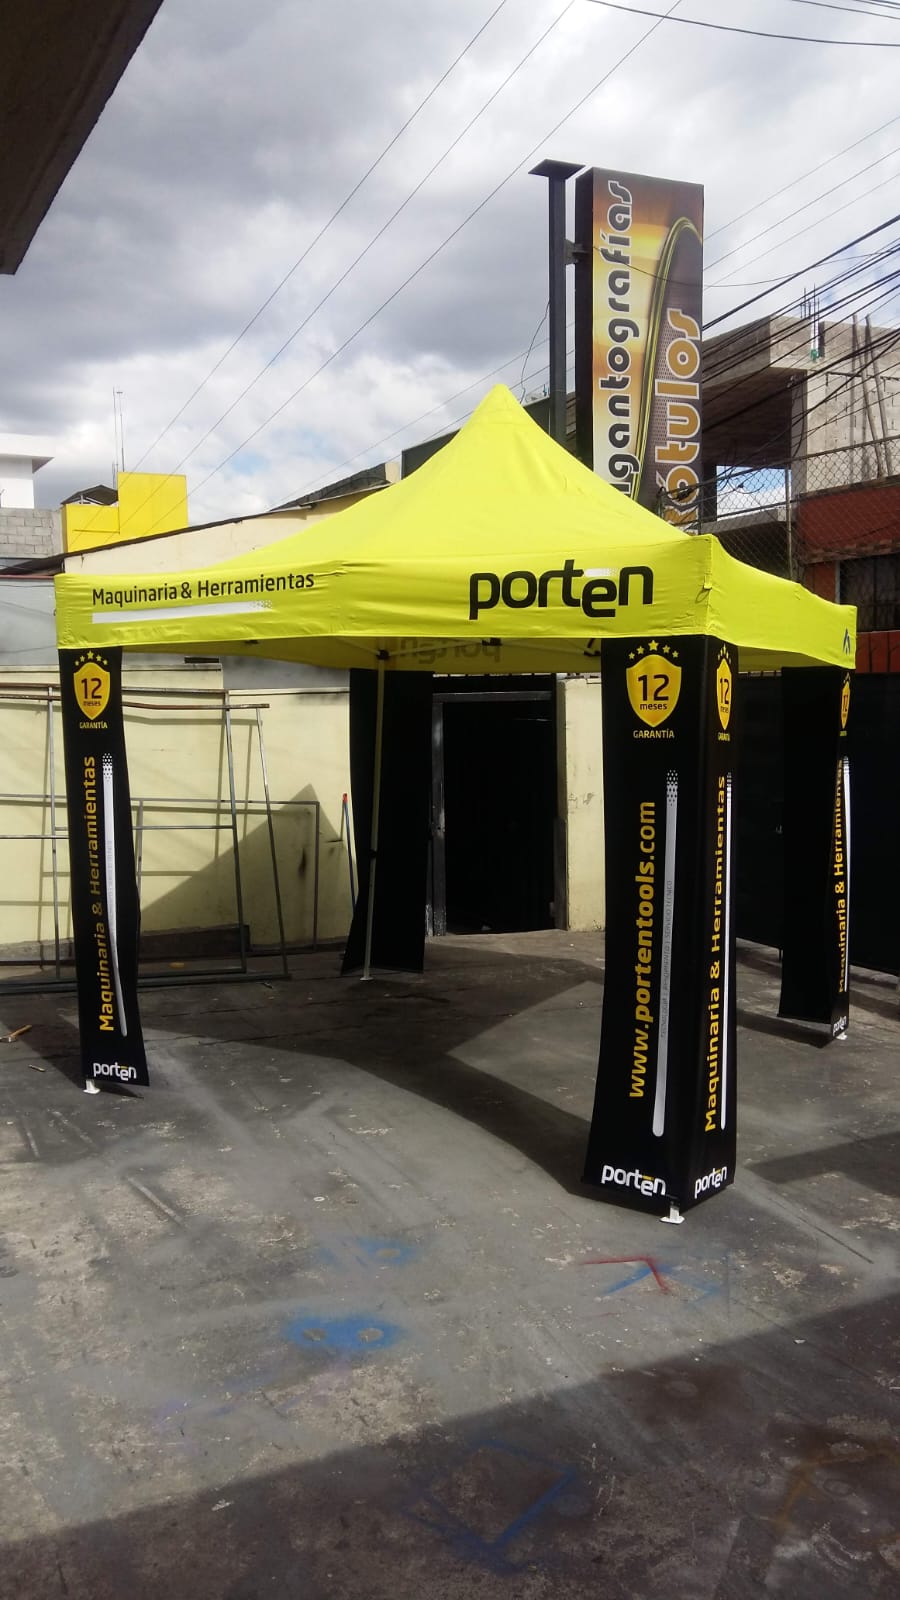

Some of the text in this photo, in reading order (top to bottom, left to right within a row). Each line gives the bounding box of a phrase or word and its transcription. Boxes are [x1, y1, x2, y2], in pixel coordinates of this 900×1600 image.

[92, 572, 315, 607] Maquinaria & Herramientas
[469, 559, 654, 620] porten
[81, 677, 102, 699] 12
[637, 674, 670, 701] 12
[720, 678, 730, 704] 12
[639, 702, 668, 711] meses
[633, 728, 675, 739] GARANTÍA
[84, 756, 101, 895] Herramientas
[91, 902, 103, 915] &
[629, 801, 656, 1098] www.portentools.com
[705, 776, 725, 1132] Maquinaria & Herramientas
[95, 922, 114, 1031] Maquinaria
[93, 1062, 137, 1081] porten
[601, 1164, 666, 1196] porten
[694, 1166, 728, 1199] porten
